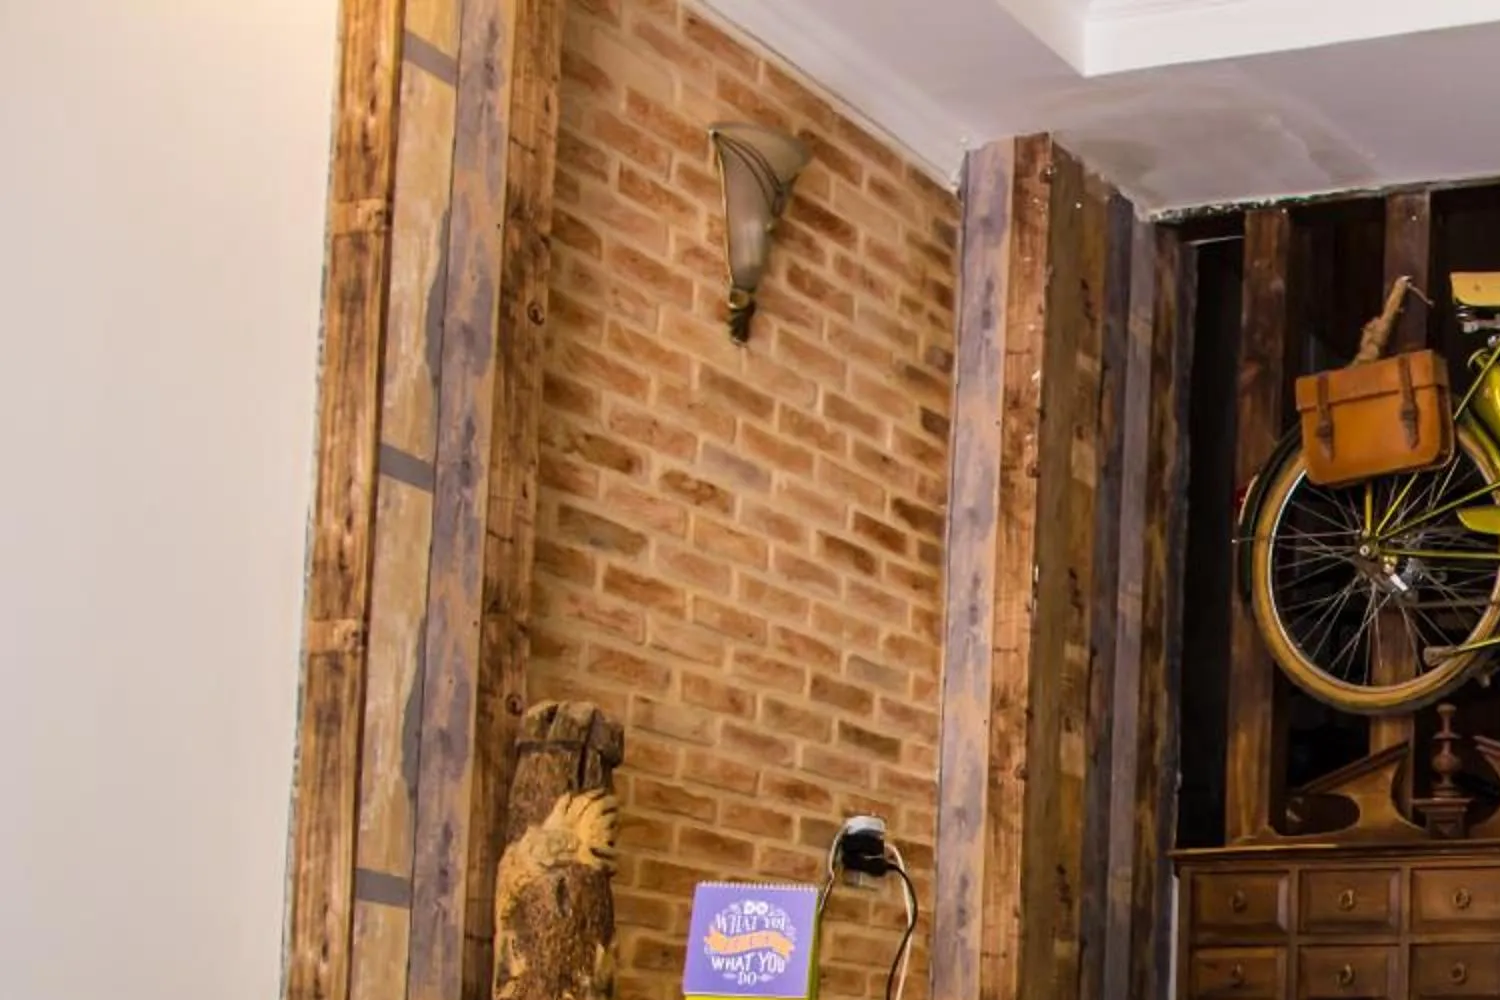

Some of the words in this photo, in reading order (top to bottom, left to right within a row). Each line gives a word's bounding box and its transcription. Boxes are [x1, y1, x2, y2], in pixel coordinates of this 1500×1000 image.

[743, 900, 769, 915] DO
[711, 952, 753, 972] WHAT
[759, 950, 786, 974] YOU
